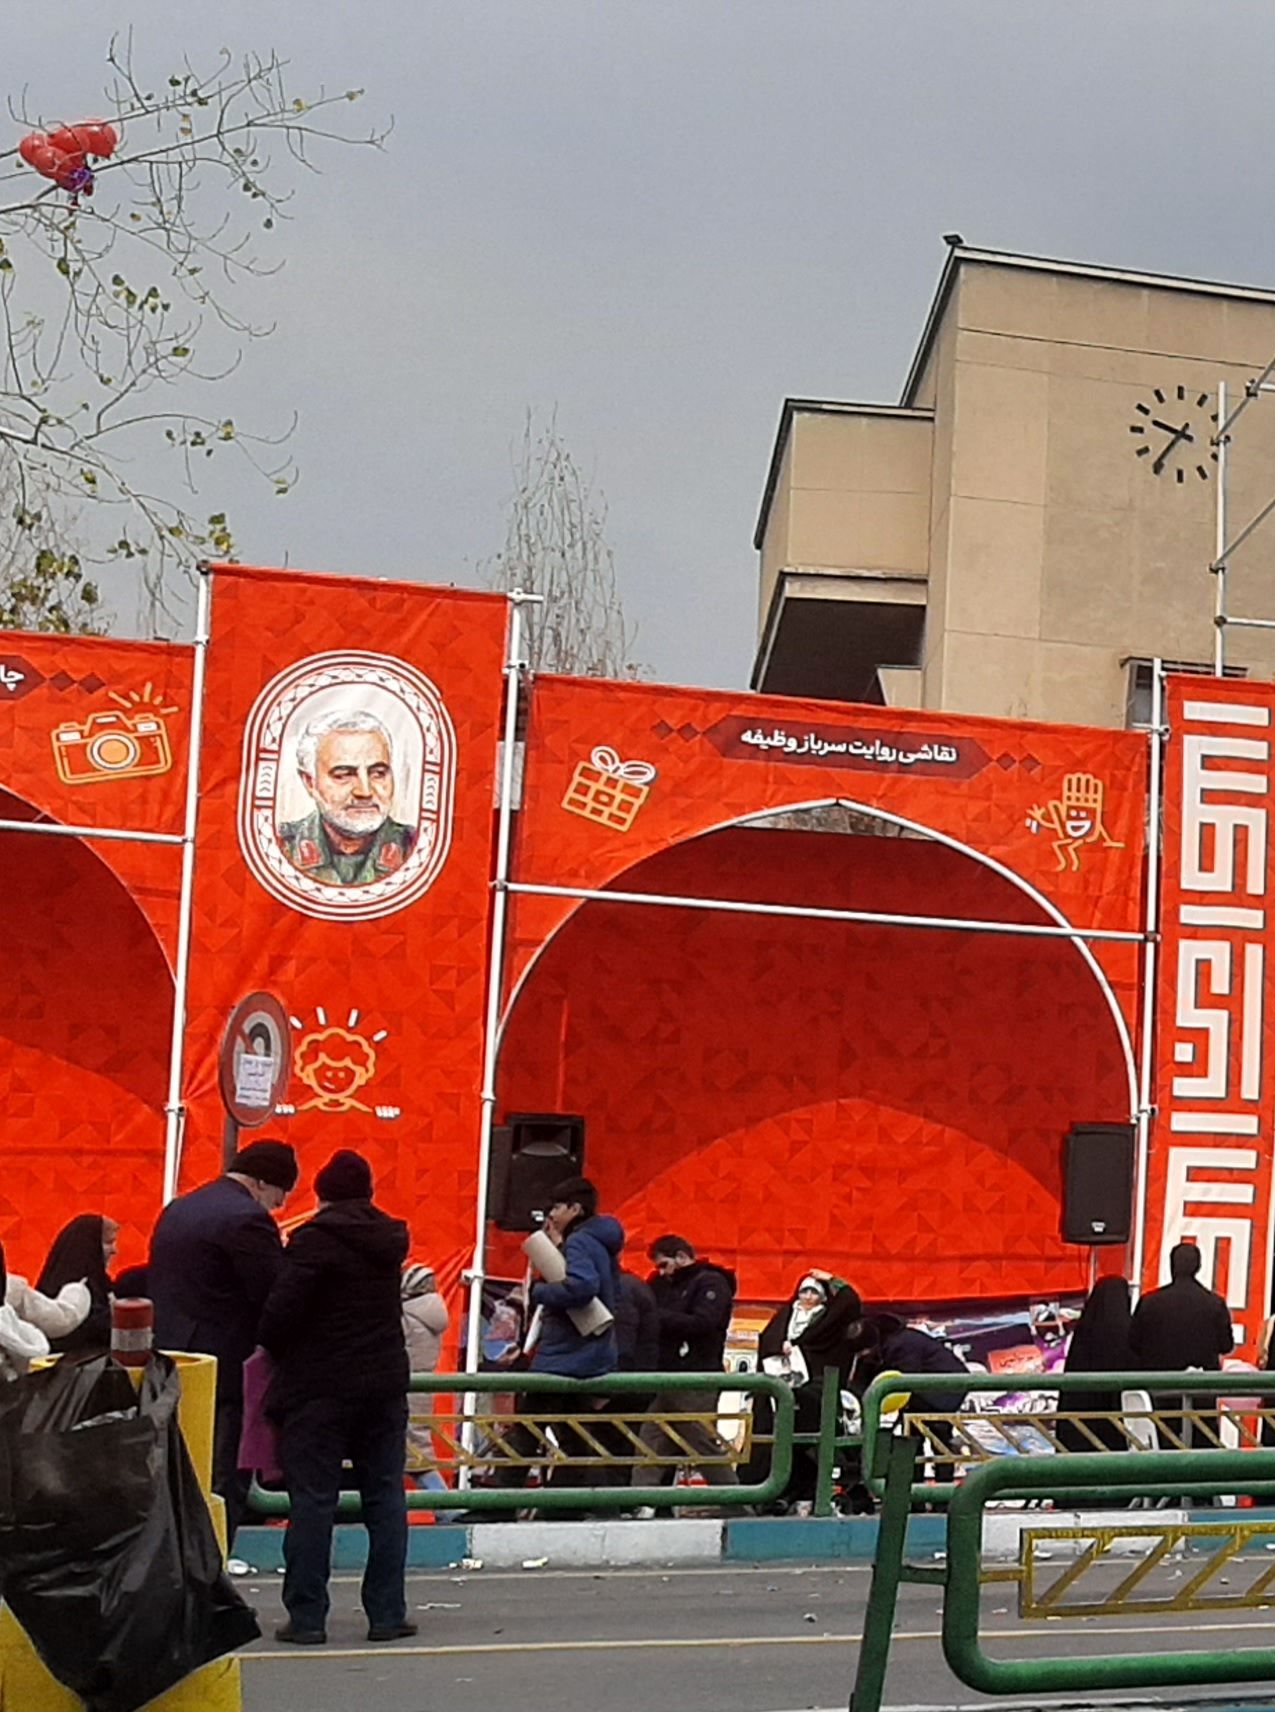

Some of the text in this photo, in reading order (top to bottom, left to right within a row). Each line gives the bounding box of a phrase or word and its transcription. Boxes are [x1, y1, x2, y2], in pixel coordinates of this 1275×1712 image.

[741, 728, 957, 763] نقاشی روایت سرباز وظیفه
